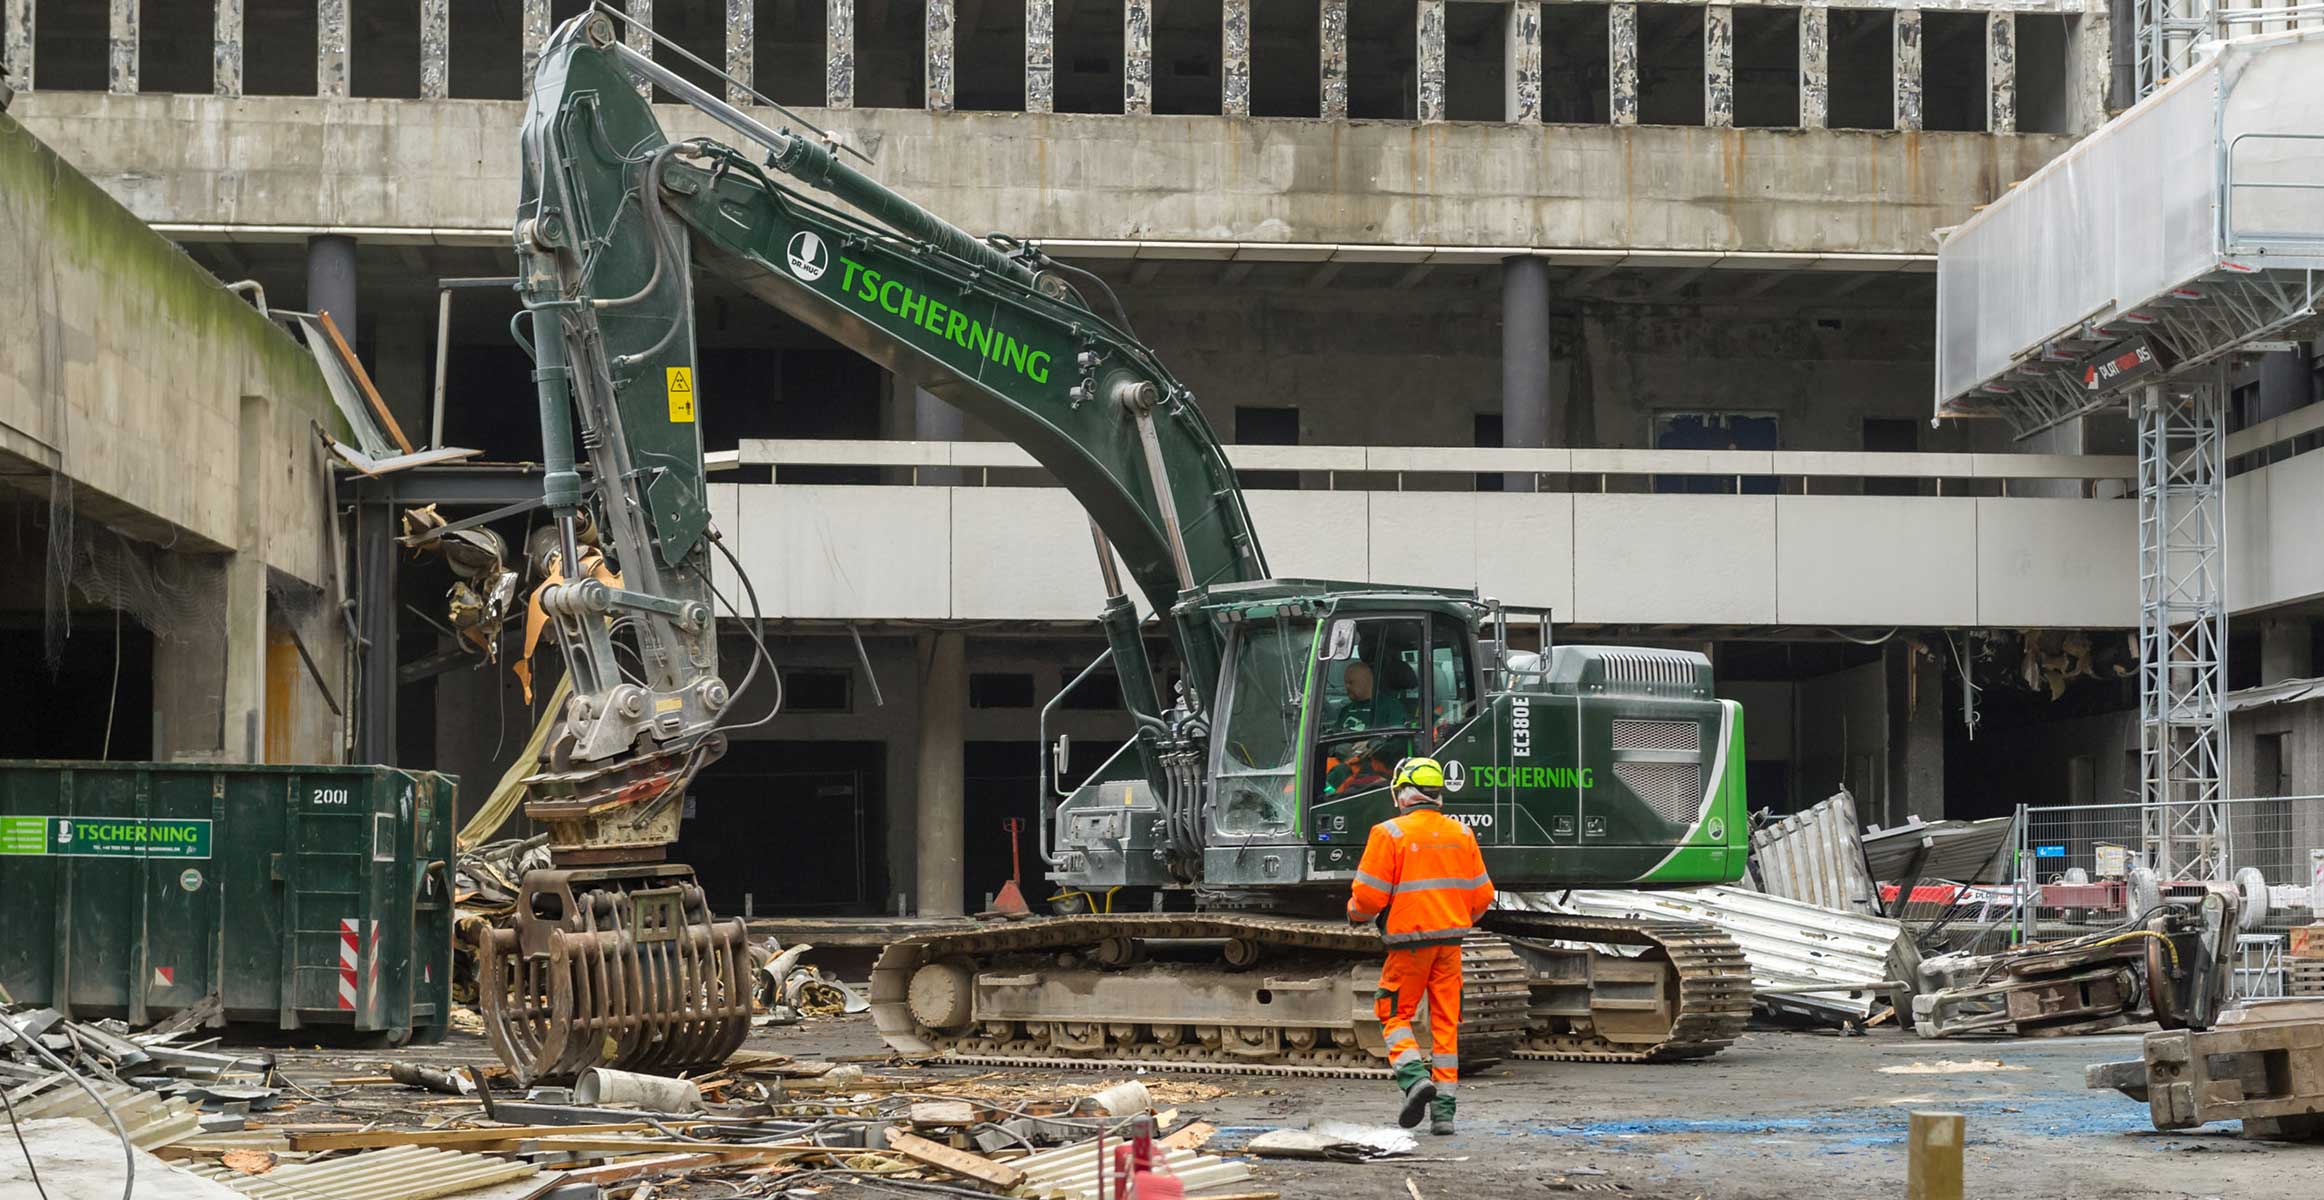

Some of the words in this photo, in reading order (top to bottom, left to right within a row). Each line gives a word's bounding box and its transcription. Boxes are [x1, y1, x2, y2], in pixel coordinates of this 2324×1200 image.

[791, 259, 819, 276] DR.HUG
[839, 256, 1051, 384] TSCHERNING
[1512, 697, 1531, 757] EC380E
[1471, 766, 1594, 789] TSCHERNING
[313, 789, 348, 804] 2001
[76, 824, 198, 843] TSCHERNING
